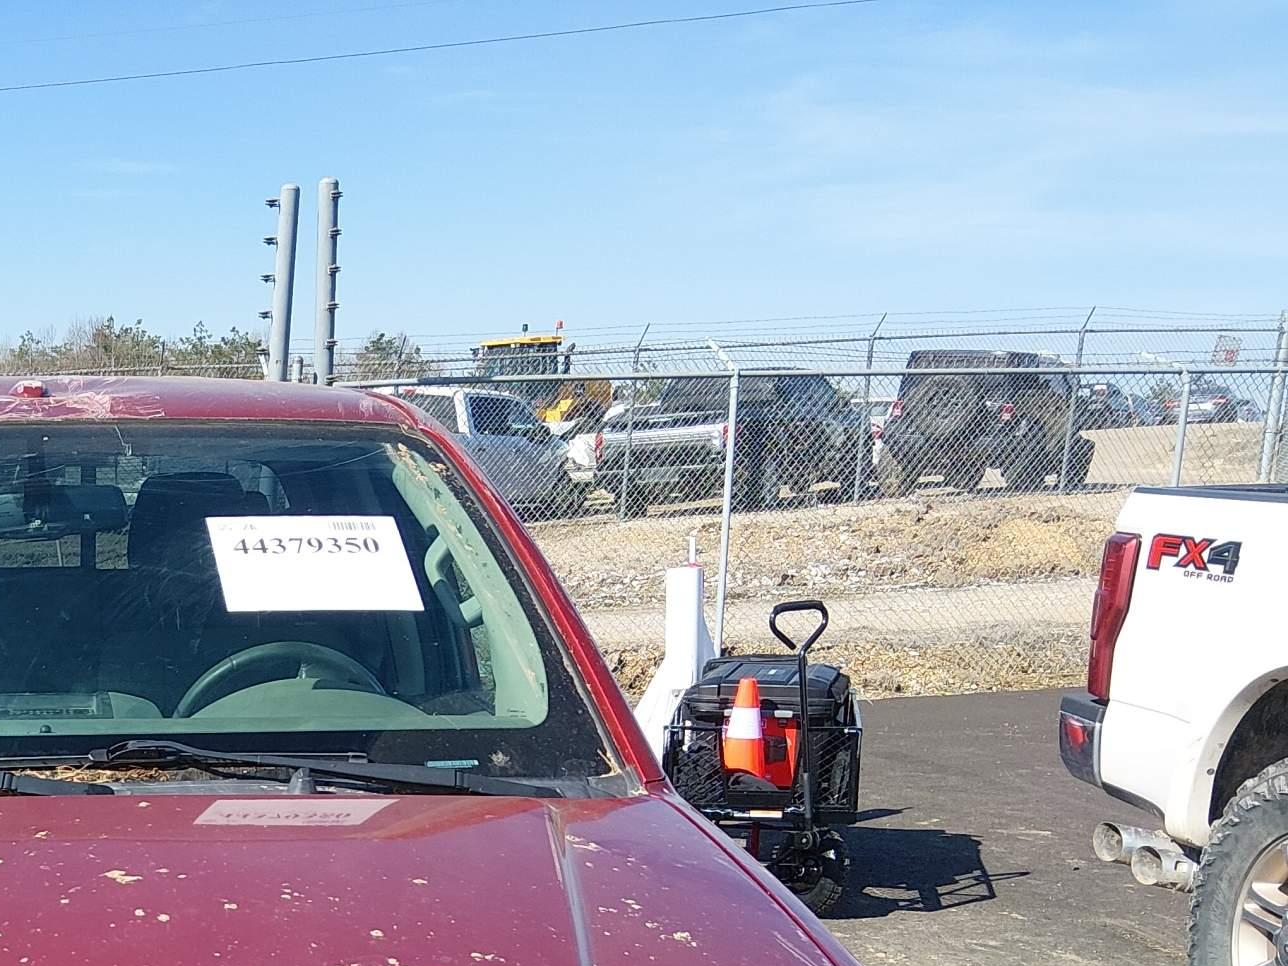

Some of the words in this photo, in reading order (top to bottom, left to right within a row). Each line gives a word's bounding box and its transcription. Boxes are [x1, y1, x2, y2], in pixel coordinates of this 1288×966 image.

[233, 536, 381, 555] 44379350
[1146, 532, 1243, 576] FX4
[1183, 570, 1204, 580] OFF
[1206, 573, 1234, 583] ROAD
